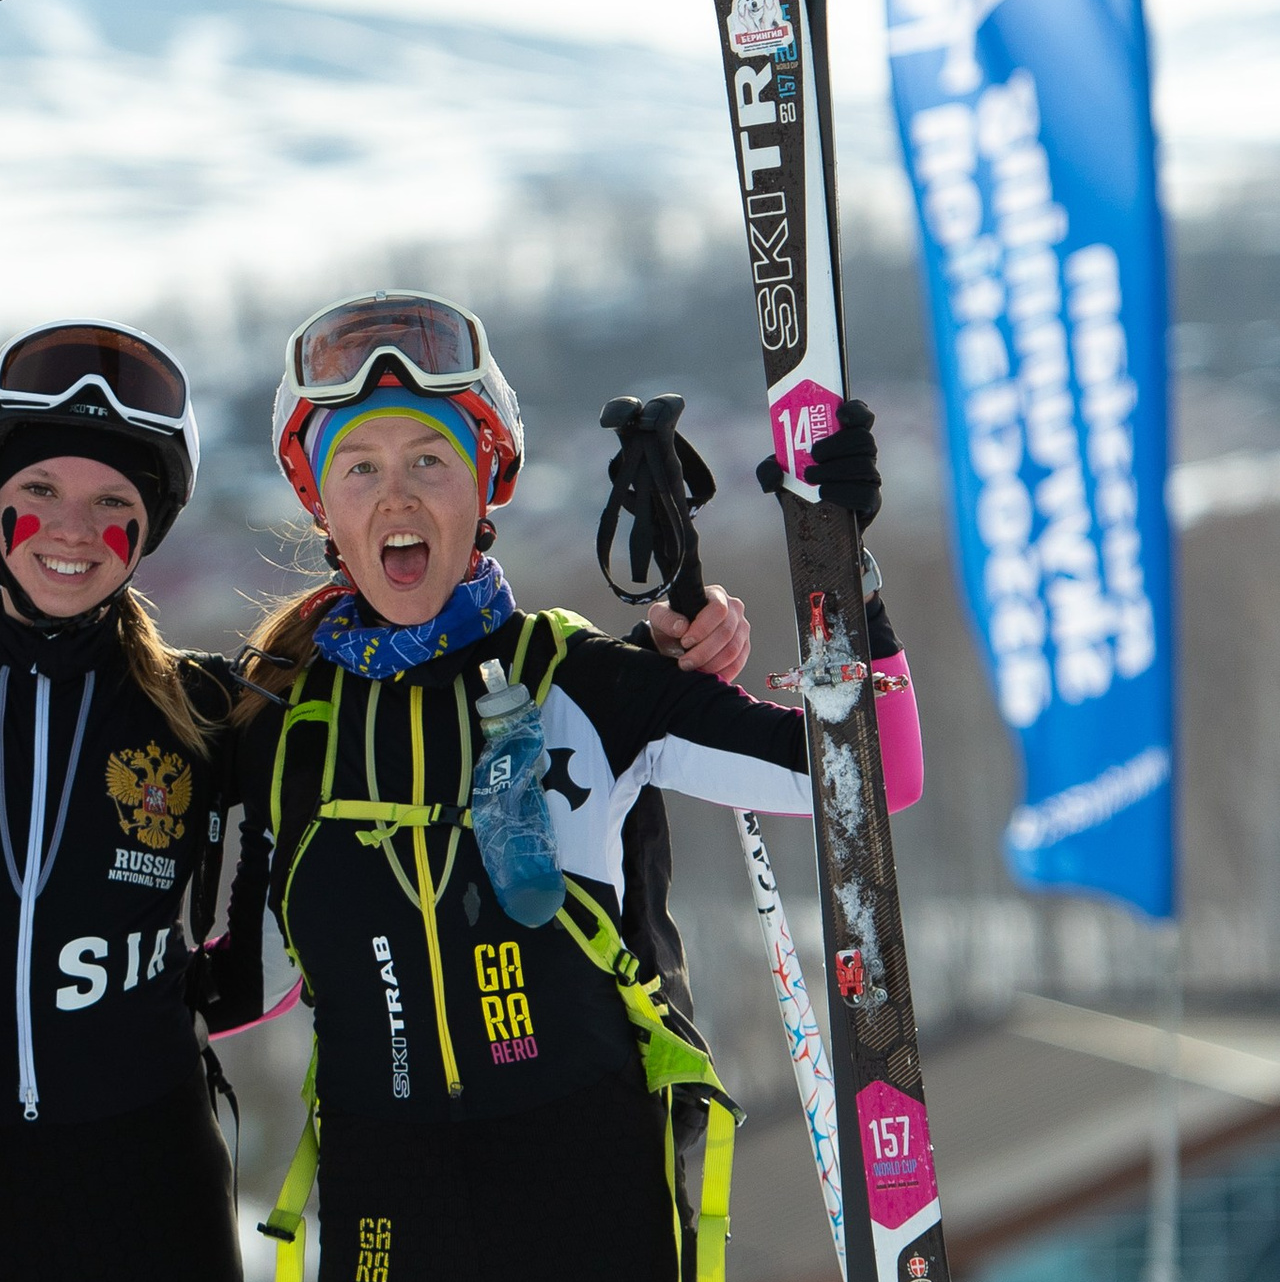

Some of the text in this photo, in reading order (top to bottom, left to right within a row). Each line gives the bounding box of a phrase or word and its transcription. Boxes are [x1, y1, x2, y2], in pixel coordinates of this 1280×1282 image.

[777, 74, 796, 99] 157
[779, 102, 797, 124] 60
[108, 869, 154, 887] NATIONAL
[114, 848, 176, 879] RUSSIA
[474, 941, 524, 992] GA
[372, 936, 410, 1098] SKITRAB
[480, 992, 534, 1042] RA
[491, 1036, 538, 1065] AERO
[869, 1115, 910, 1159] 157
[873, 1158, 918, 1177] WORLD CUP
